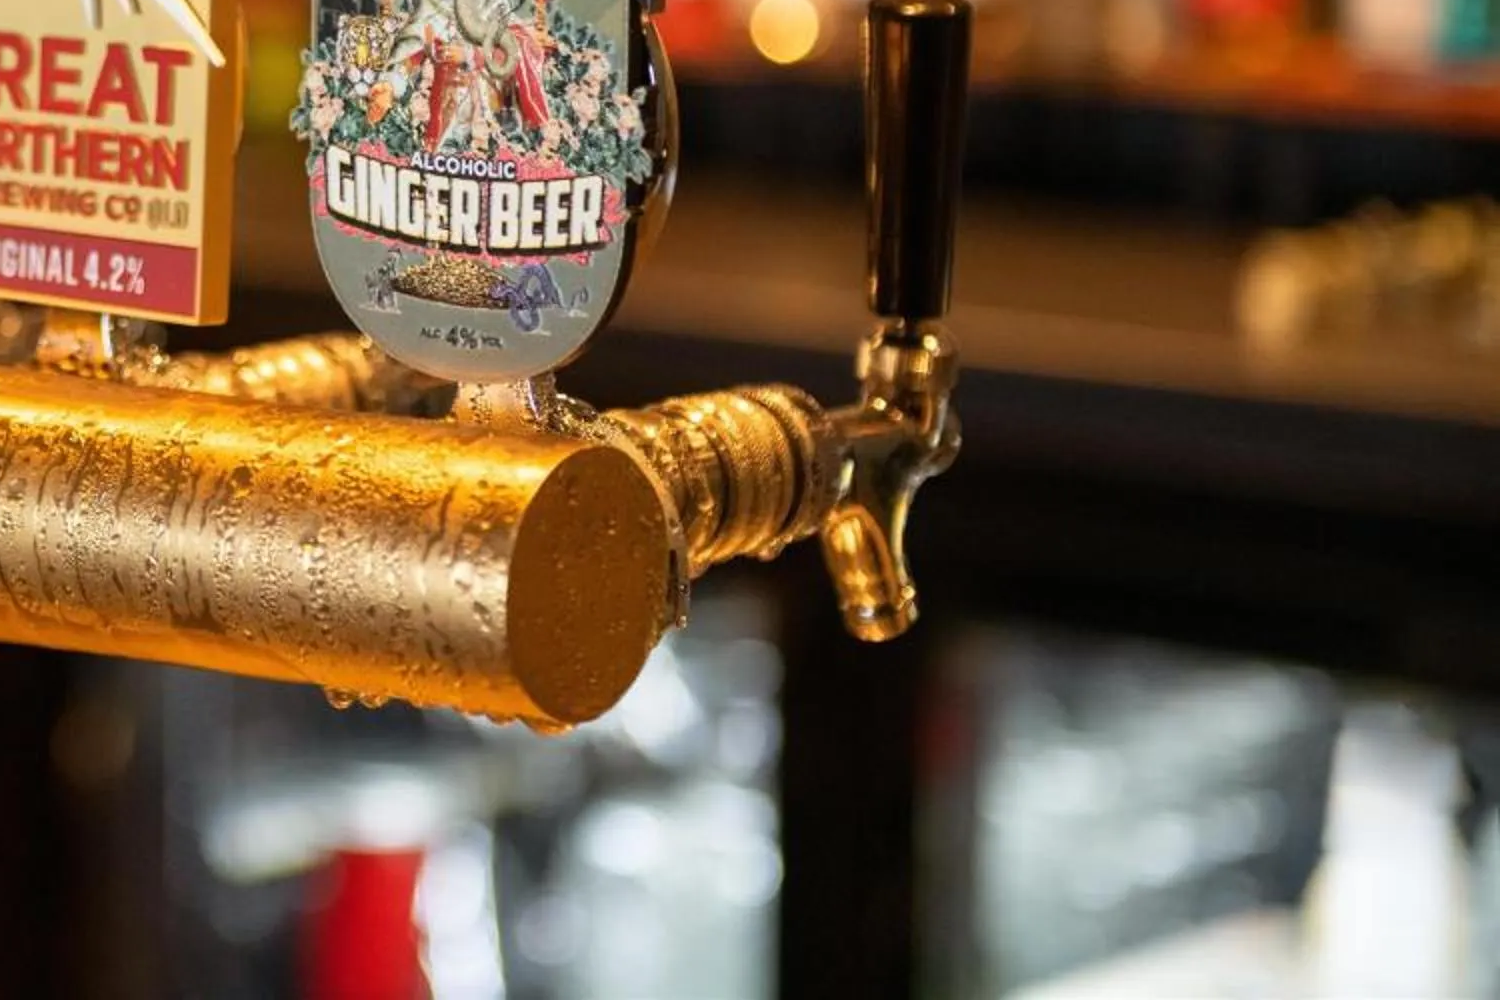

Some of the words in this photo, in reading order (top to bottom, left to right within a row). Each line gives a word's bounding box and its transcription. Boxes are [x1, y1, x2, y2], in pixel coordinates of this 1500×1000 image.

[411, 151, 517, 180] ALCOHOLIC
[324, 144, 482, 250] GINGER
[487, 174, 605, 250] BEER
[84, 249, 146, 296] 4.2%
[419, 326, 441, 339] ALC
[446, 325, 479, 350] 4%
